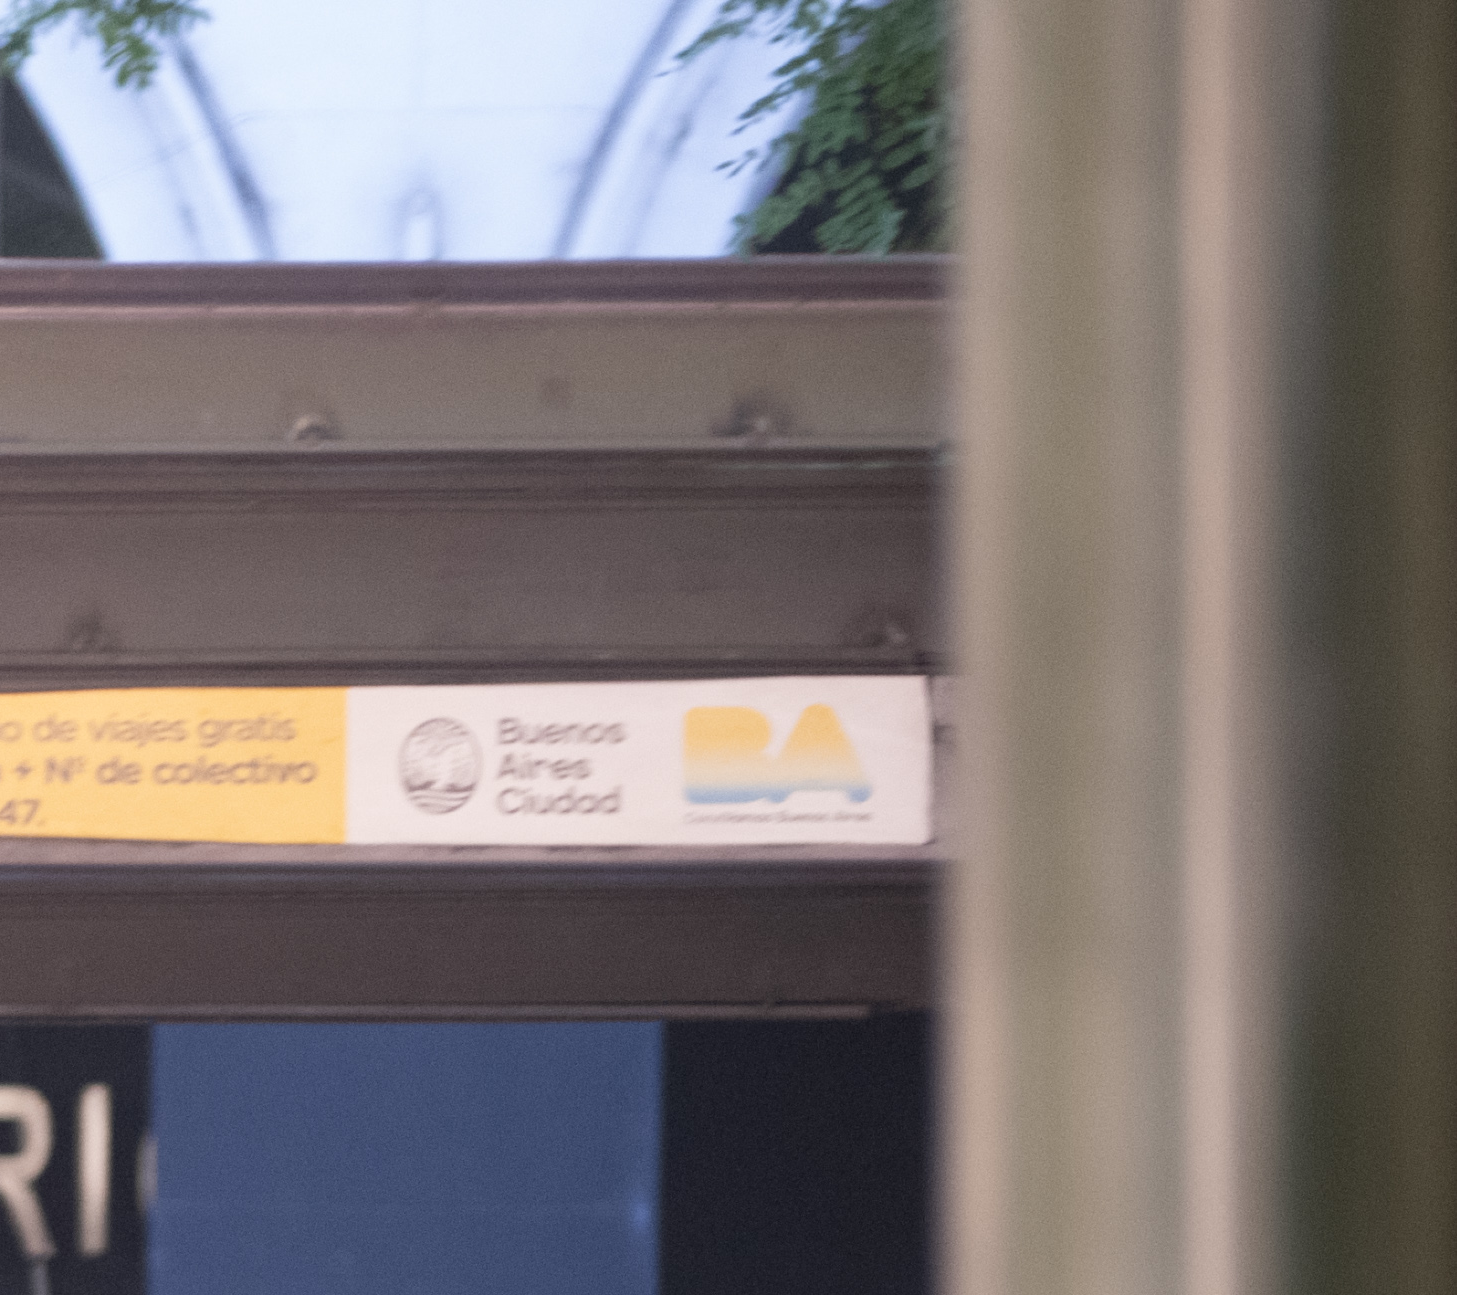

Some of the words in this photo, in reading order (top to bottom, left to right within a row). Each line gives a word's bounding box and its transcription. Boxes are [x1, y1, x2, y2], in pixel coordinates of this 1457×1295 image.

[32, 713, 77, 742] de
[87, 712, 187, 748] viajes
[197, 712, 297, 749] gratis
[495, 717, 626, 746] Buenos
[95, 756, 141, 786] de
[152, 755, 318, 786] colectivo
[495, 752, 592, 780] Aires
[495, 786, 623, 815] Ciudad
